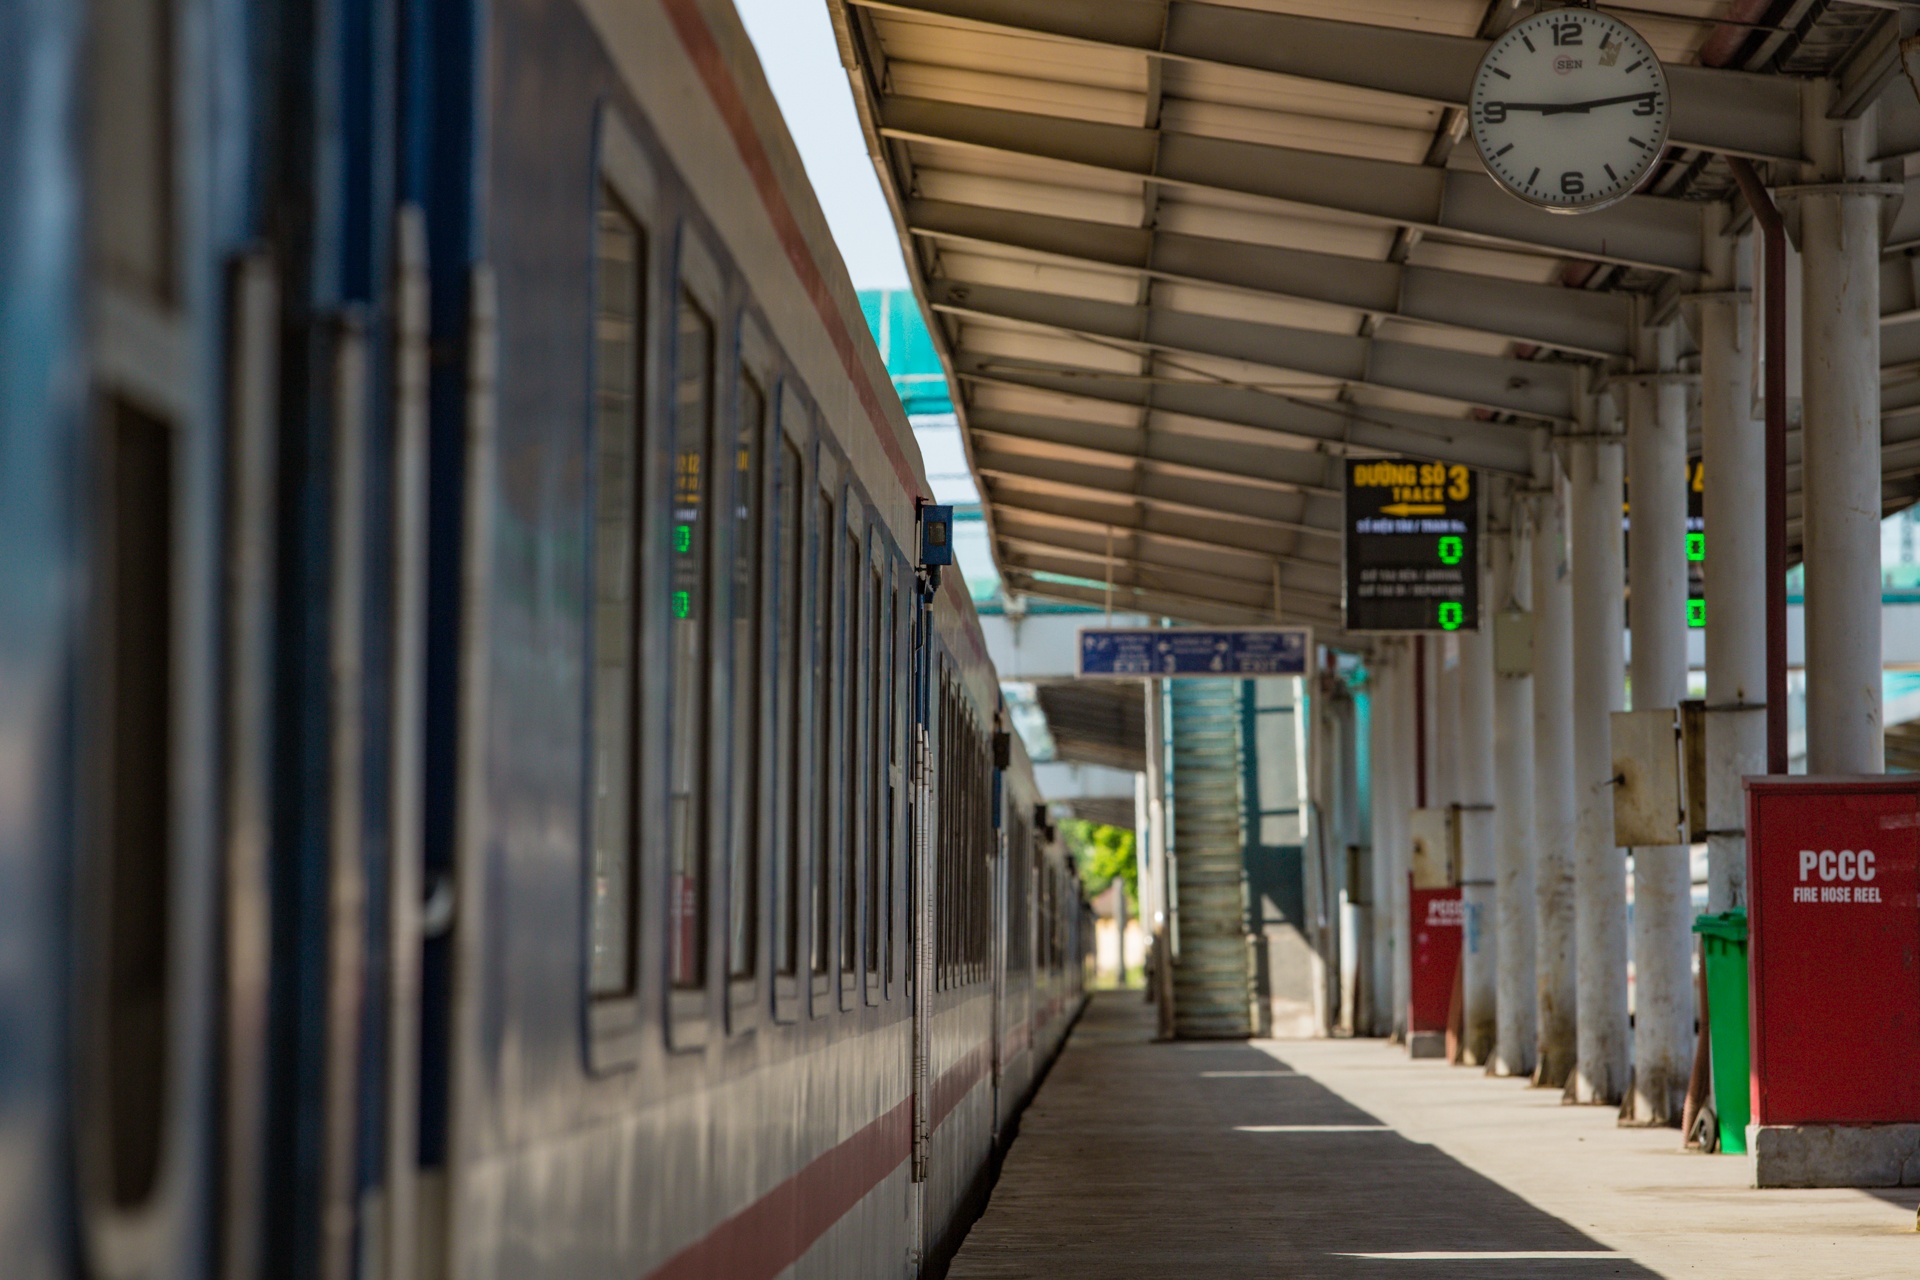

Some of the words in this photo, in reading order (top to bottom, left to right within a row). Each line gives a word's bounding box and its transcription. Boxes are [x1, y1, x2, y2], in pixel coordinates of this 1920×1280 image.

[1551, 23, 1583, 46] 12
[1557, 60, 1583, 69] SEN
[1483, 101, 1507, 124] 9
[1632, 95, 1656, 116] 3
[1560, 171, 1584, 195] 6
[1392, 486, 1444, 502] TRACK
[1447, 464, 1470, 501] 3
[1438, 536, 1463, 565] 0
[1438, 602, 1463, 631] 0
[1799, 849, 1876, 882] PCCC
[1793, 887, 1818, 903] FIRE
[1821, 887, 1851, 903] HOSE
[1854, 887, 1882, 903] REEL
